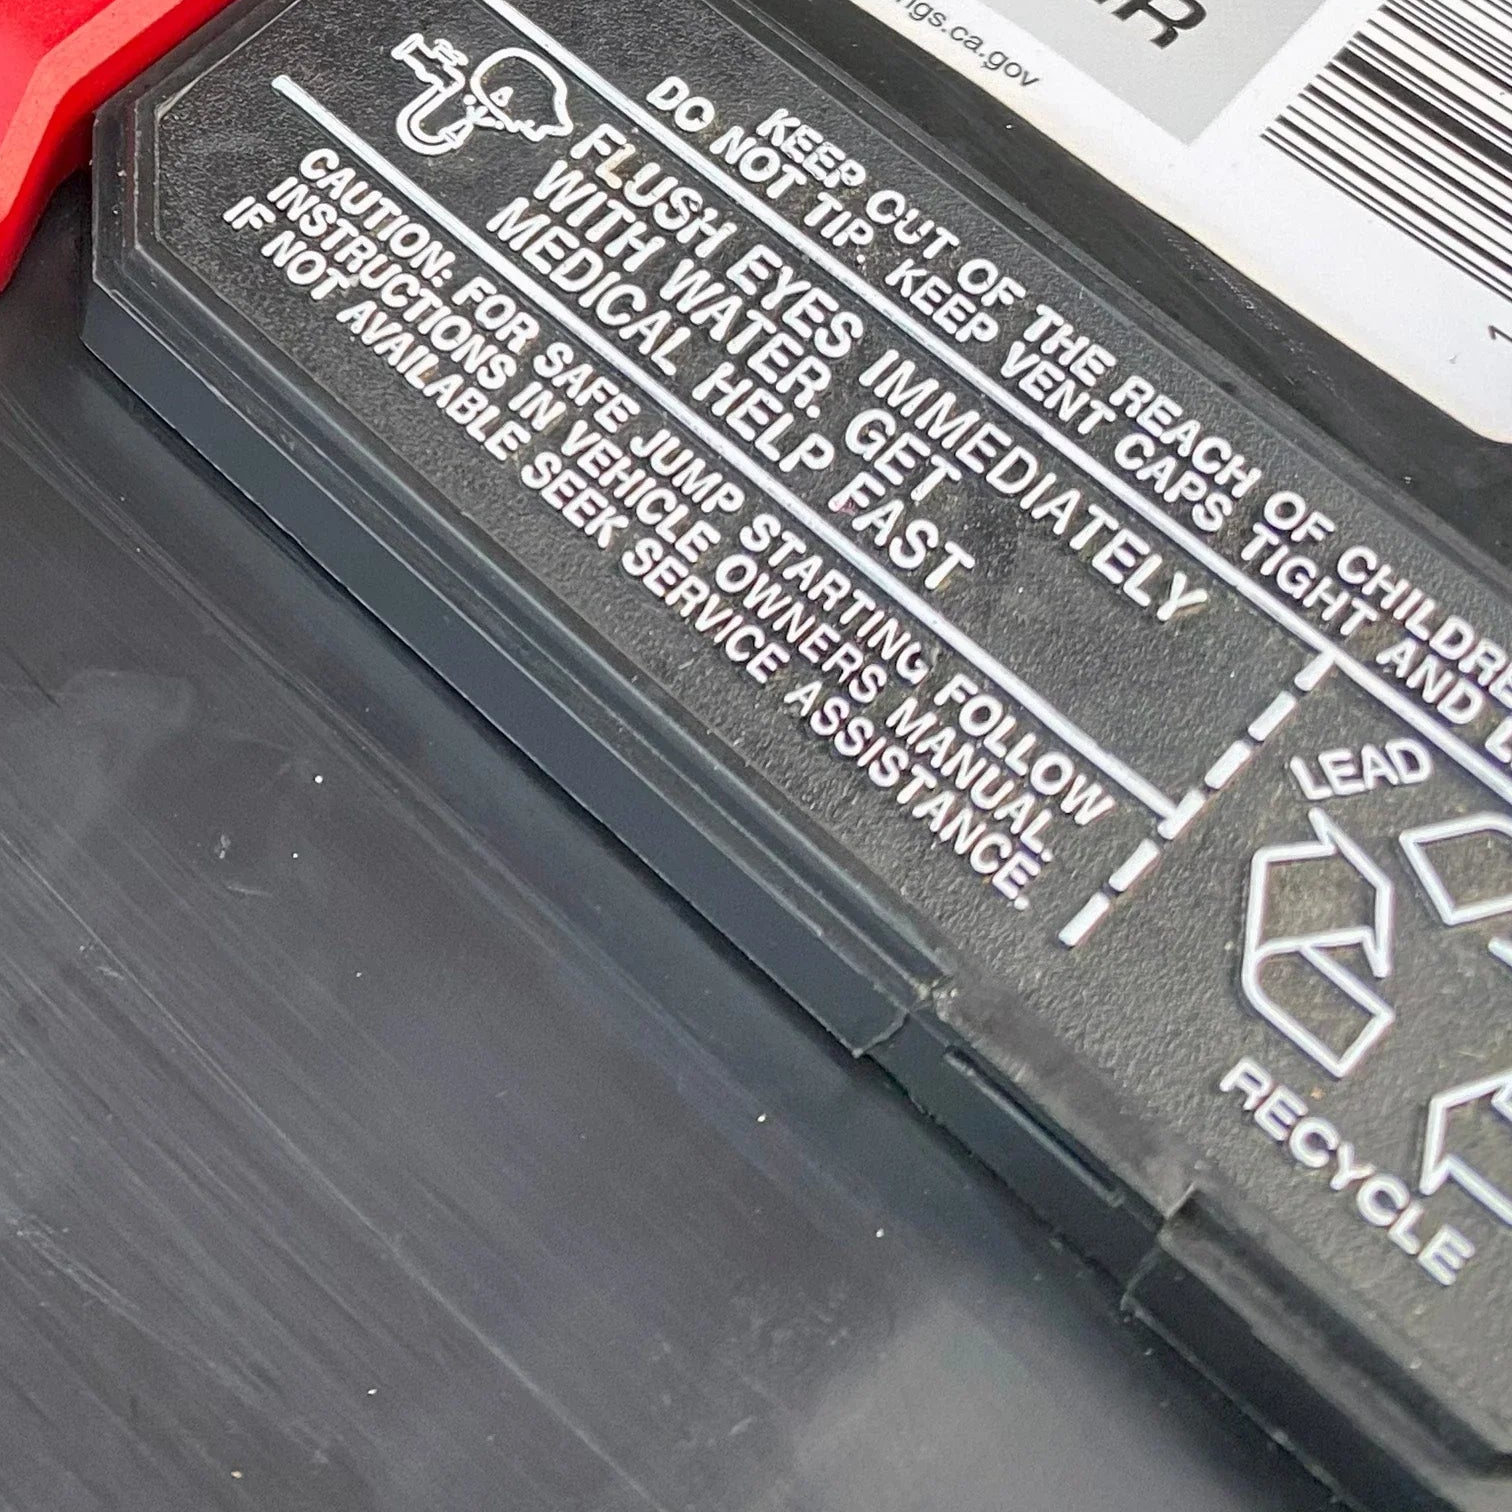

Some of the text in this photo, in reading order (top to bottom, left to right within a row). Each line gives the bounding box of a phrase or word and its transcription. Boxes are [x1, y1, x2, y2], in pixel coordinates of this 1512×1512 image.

[223, 196, 1042, 911] IF NOT AVAILABLE SEEK SERVICE ASSISTANCE.
[267, 176, 1053, 863] INSTRUCTIONS IN VEHICLE OWNERS MANUAL.
[299, 147, 1116, 826] CAUTION: FOR SAFE JUMP STARTING FOLLOW
[486, 197, 975, 590] MEDICAL HELP FAST
[532, 161, 962, 502] WITH WATER. GET
[570, 123, 1208, 621] FLUSH EYES IMMEDIATELY
[709, 126, 807, 199] NOT
[803, 192, 874, 264] TIP.
[885, 258, 998, 343] KEEP
[1000, 341, 1116, 434] VENT
[1114, 432, 1233, 532] CAPS
[1241, 521, 1377, 637] TIGHT
[1376, 638, 1486, 724] AND
[756, 108, 865, 188] KEEP
[865, 190, 959, 259] OUT
[957, 259, 1026, 307] OF
[1022, 303, 1117, 388] THE
[1109, 376, 1262, 498] REACH
[1263, 491, 1335, 544] OF
[1290, 737, 1432, 801] LEAD
[1220, 1056, 1475, 1286] RECYCLE
